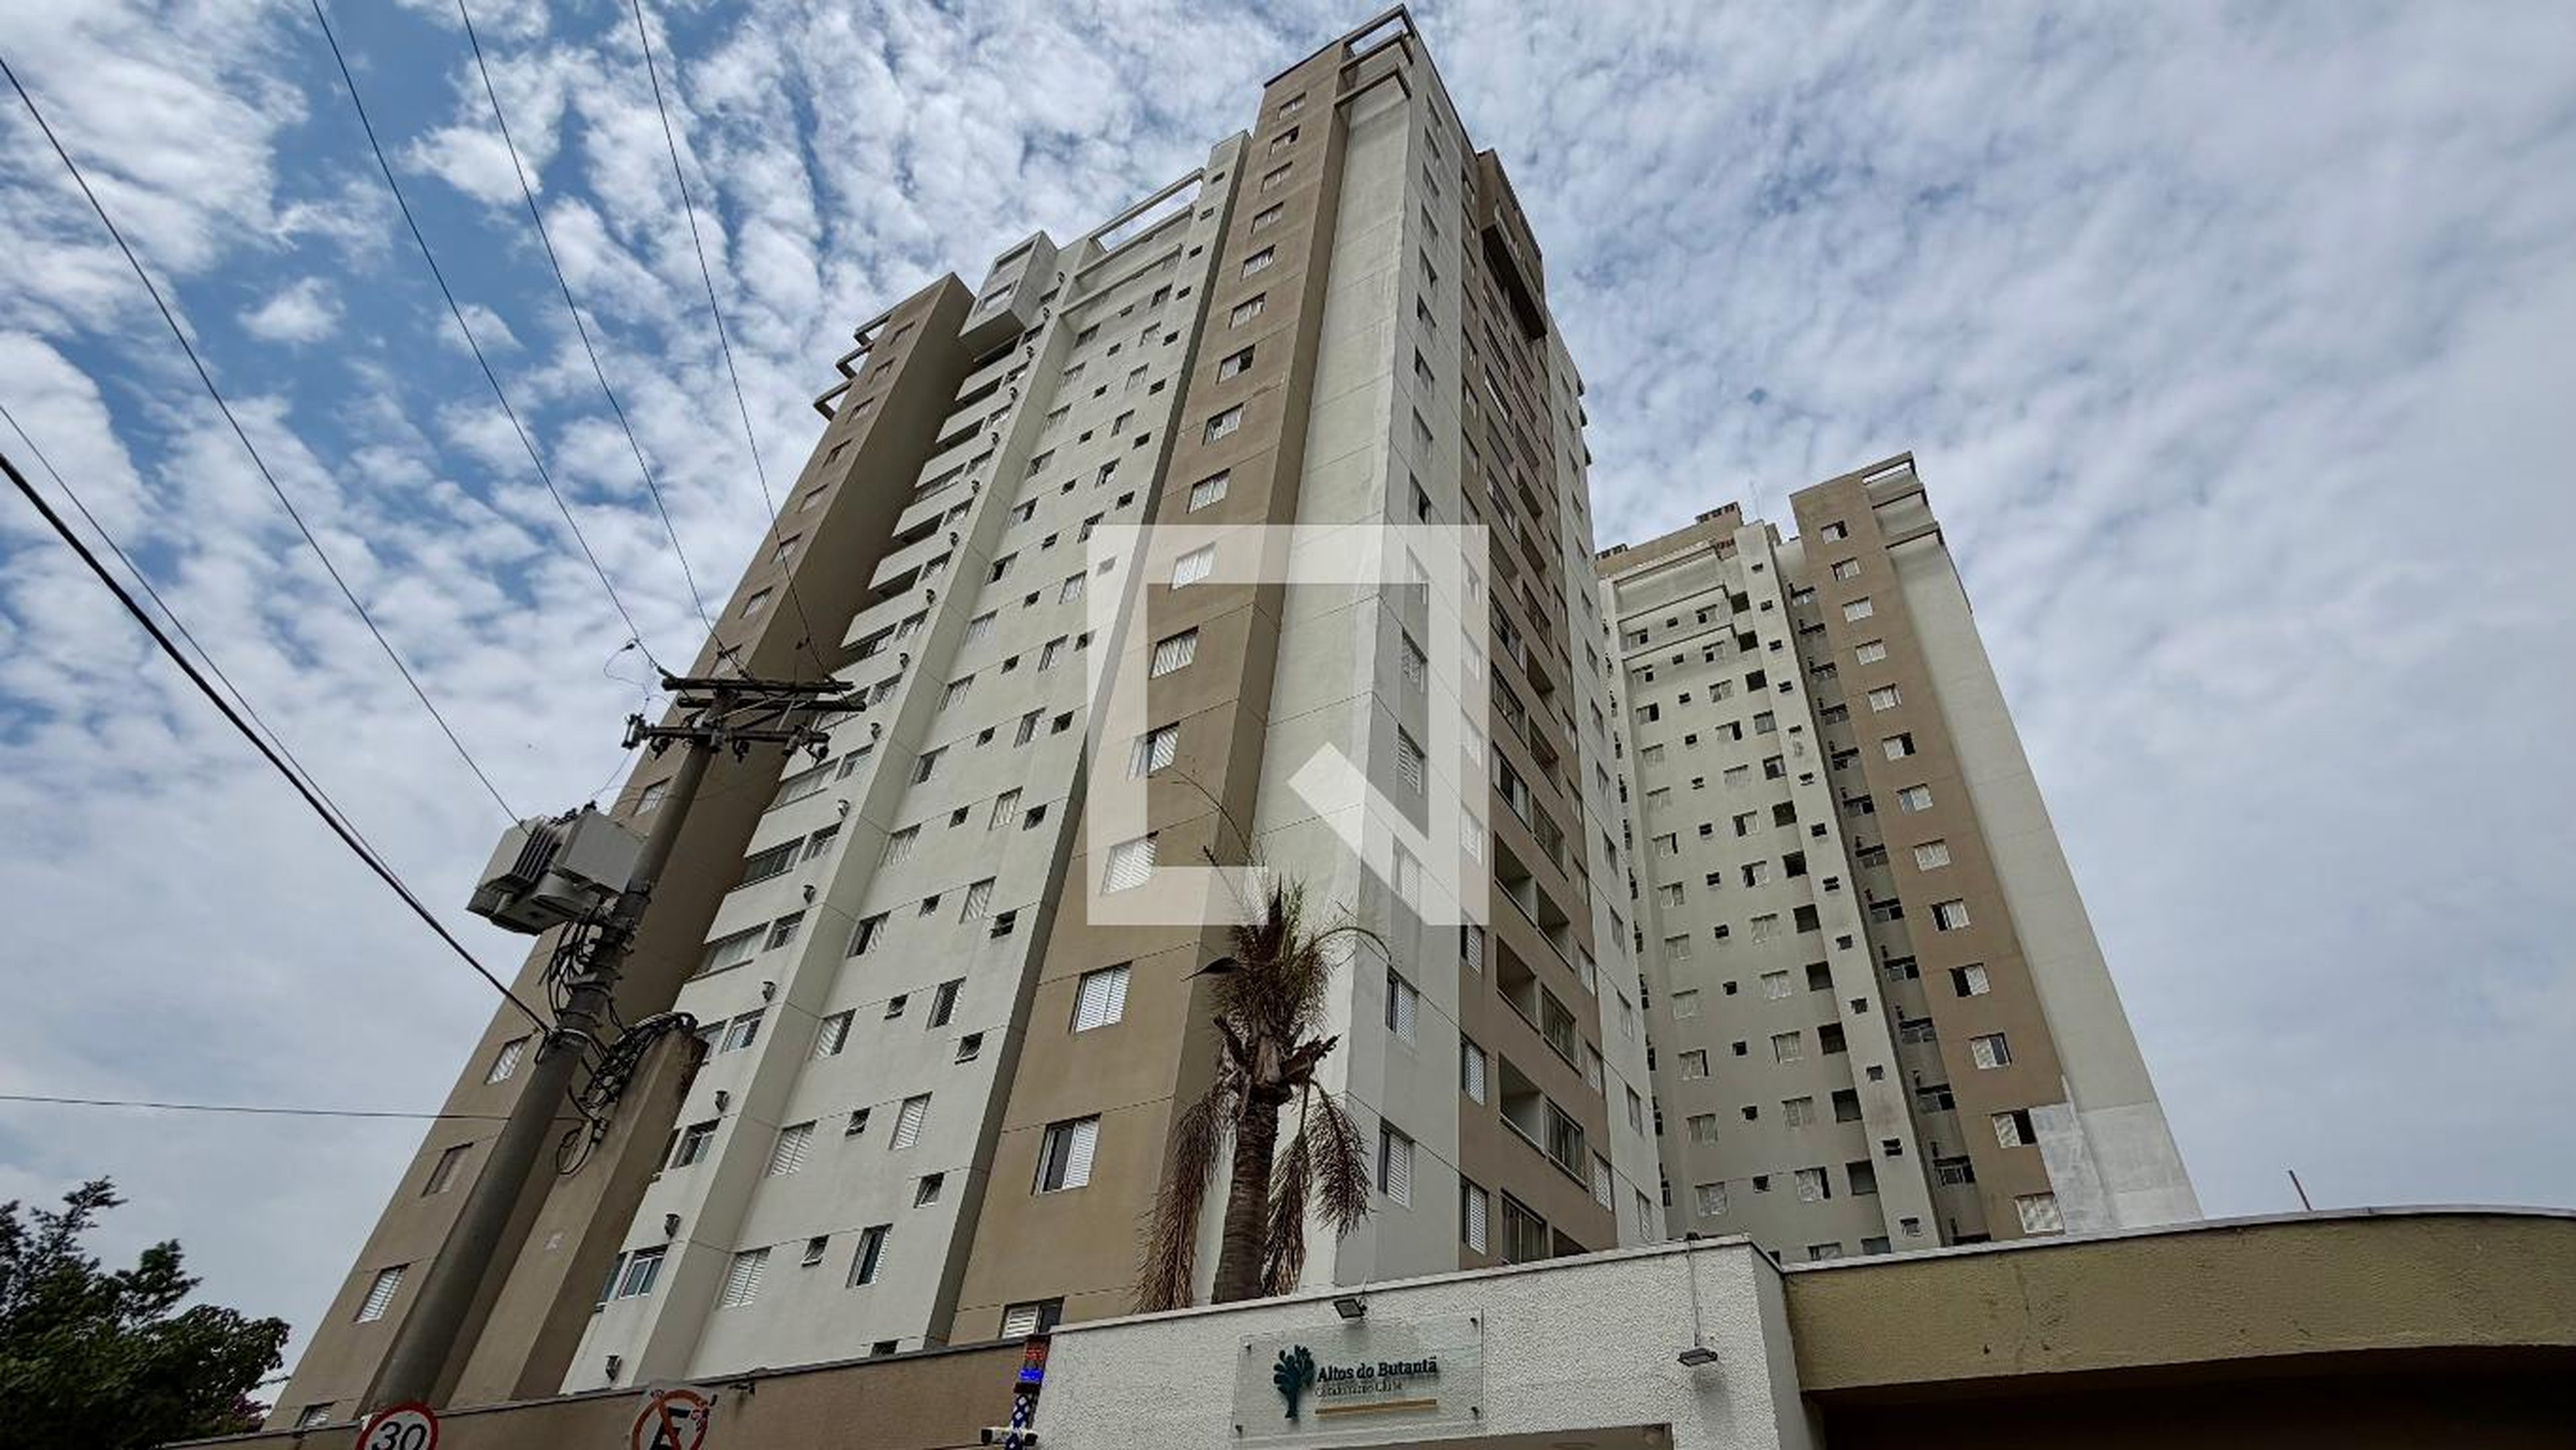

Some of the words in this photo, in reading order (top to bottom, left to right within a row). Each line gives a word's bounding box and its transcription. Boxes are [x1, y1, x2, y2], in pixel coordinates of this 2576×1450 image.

[1317, 1366, 1354, 1382] Altos
[1356, 1363, 1375, 1379] do
[1378, 1355, 1437, 1376] Butantã
[371, 1421, 427, 1450] 30
